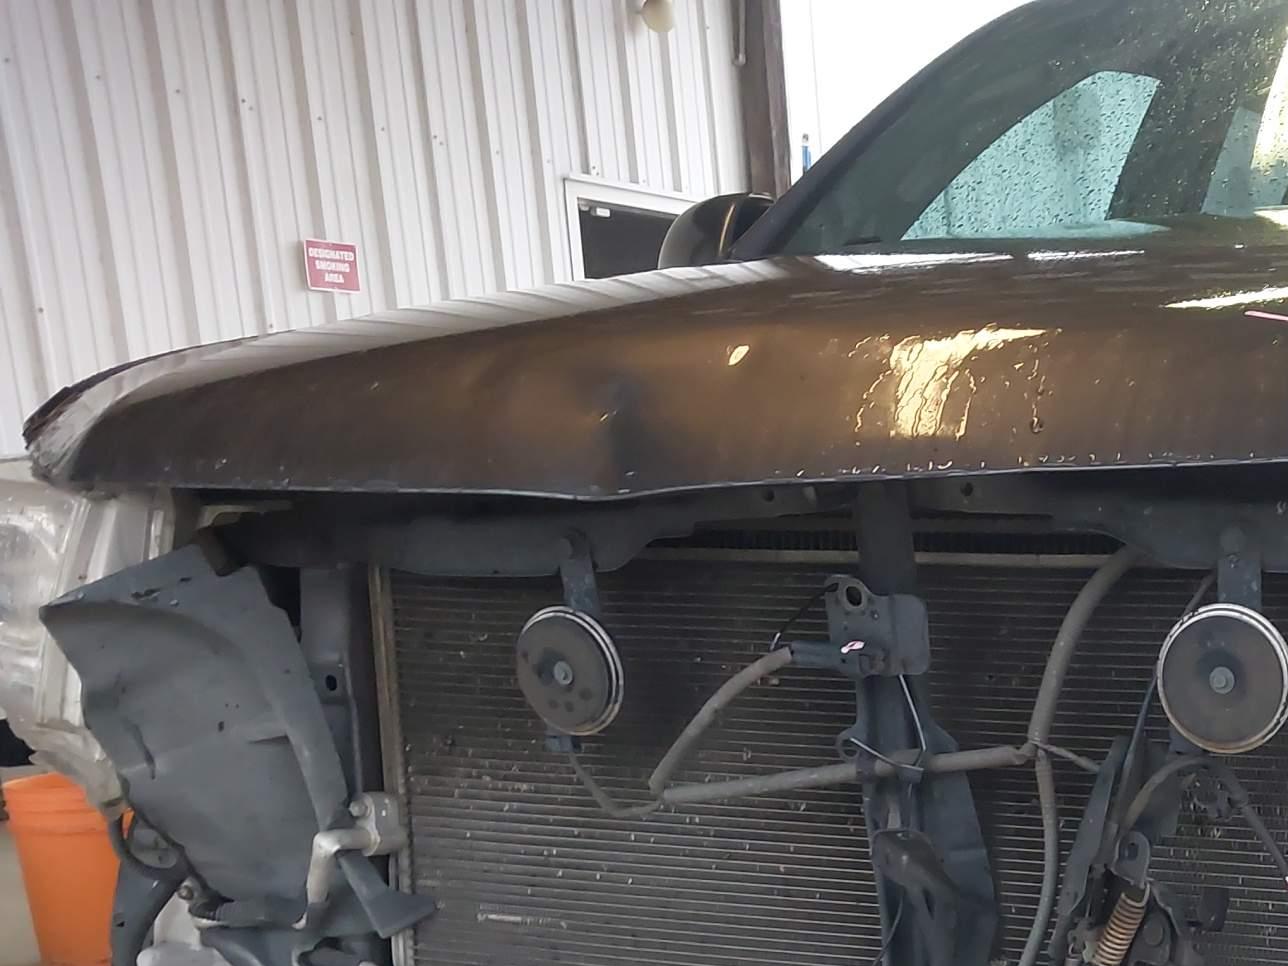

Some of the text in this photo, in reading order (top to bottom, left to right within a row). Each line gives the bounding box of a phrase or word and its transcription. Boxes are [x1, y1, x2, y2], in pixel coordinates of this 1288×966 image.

[308, 247, 354, 261] DESIGNATED
[315, 260, 350, 272] SMOKING
[324, 272, 344, 283] AREA
